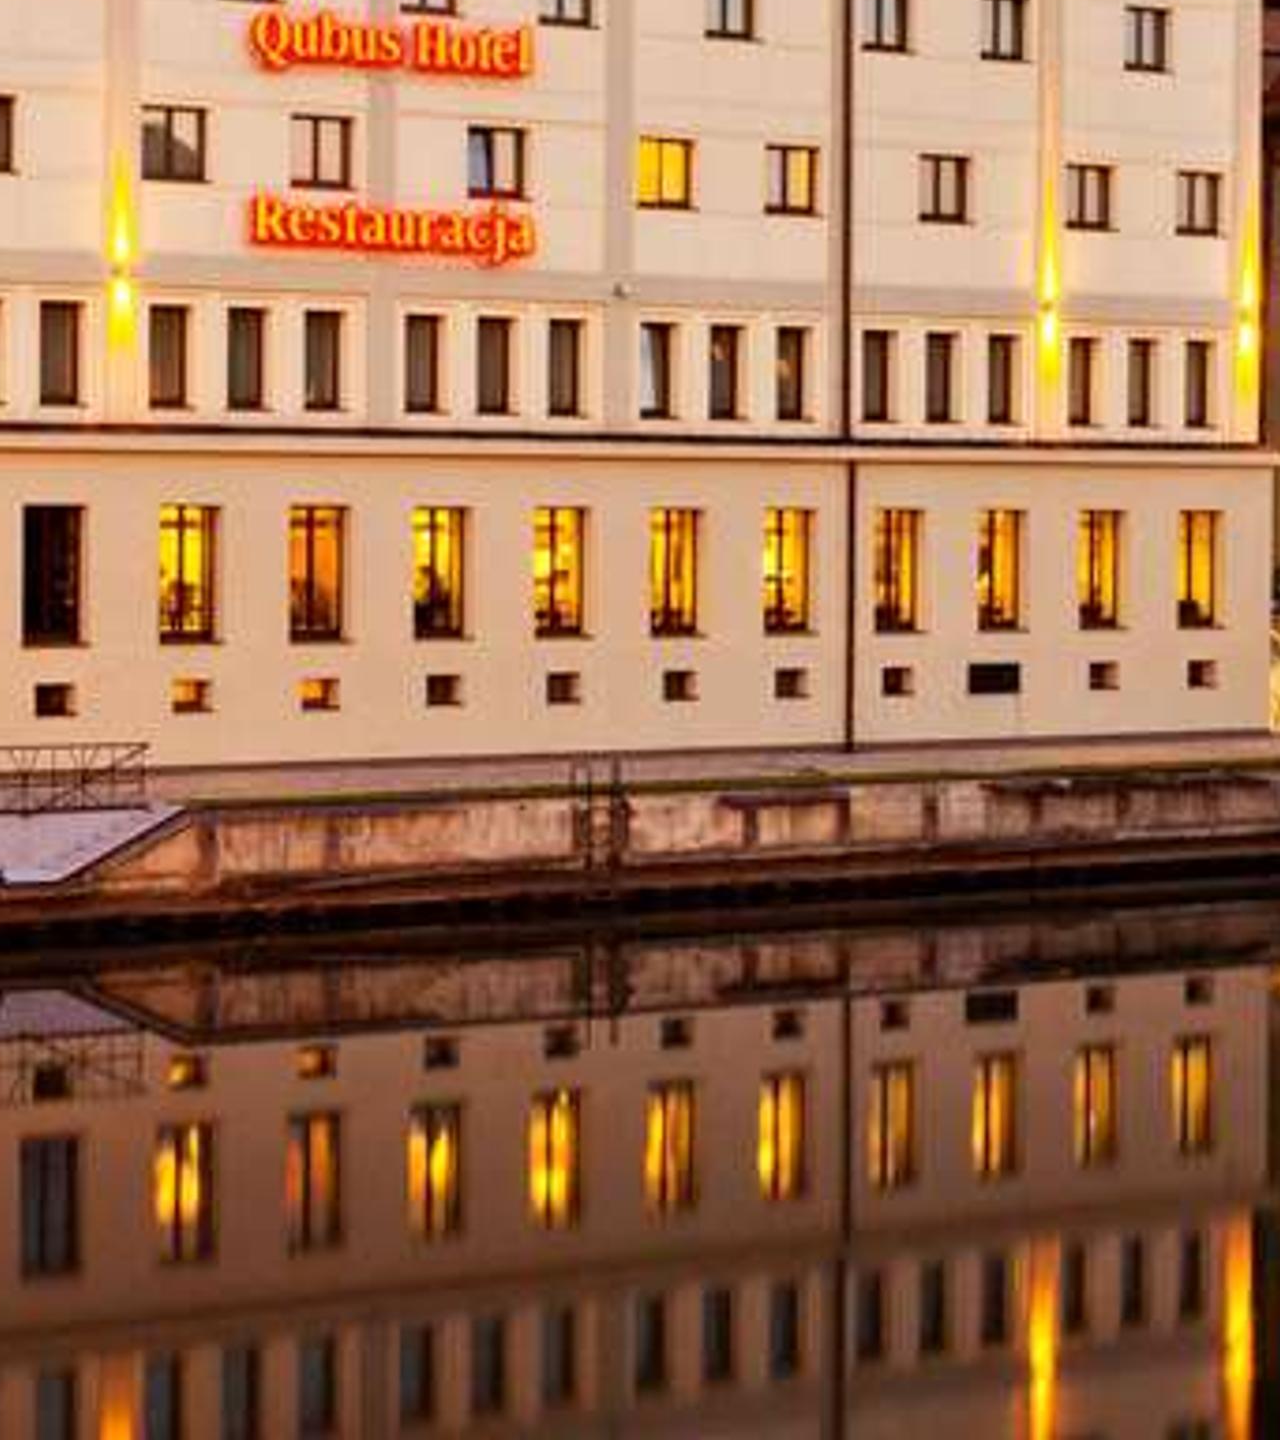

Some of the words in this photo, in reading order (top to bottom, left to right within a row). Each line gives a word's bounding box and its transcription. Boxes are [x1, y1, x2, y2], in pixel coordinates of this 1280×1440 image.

[251, 8, 404, 69] Qubus
[412, 21, 533, 76] Hotel
[251, 193, 534, 264] Restauracja
